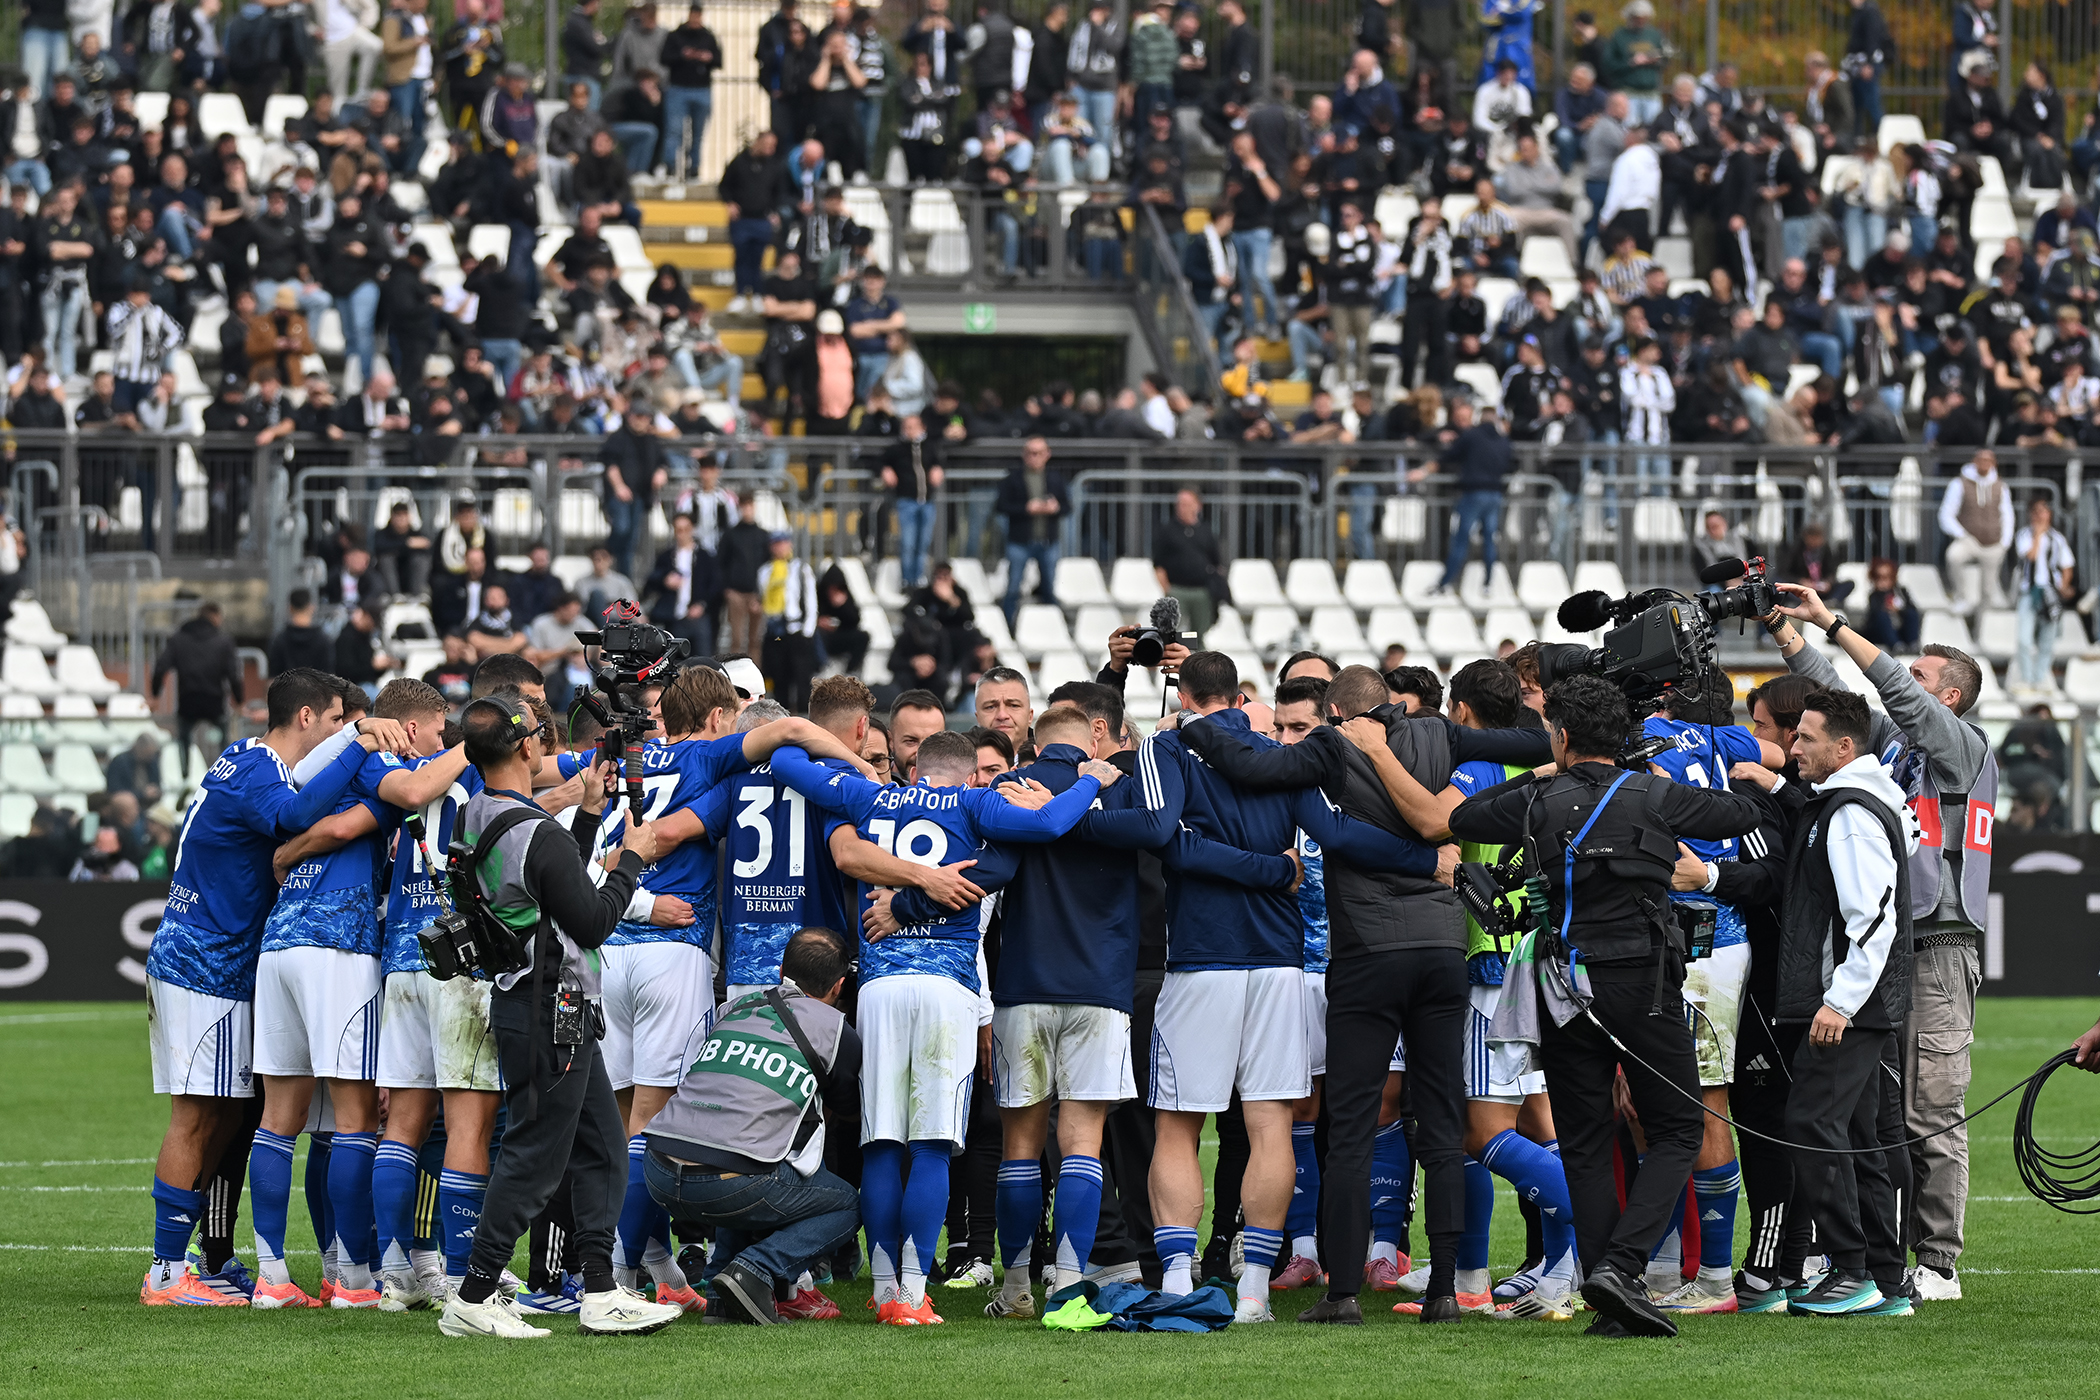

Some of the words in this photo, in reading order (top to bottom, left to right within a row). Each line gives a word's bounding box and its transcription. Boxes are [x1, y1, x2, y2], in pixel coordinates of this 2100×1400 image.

[649, 658, 670, 677] RONIN
[733, 786, 806, 878] 31
[734, 885, 806, 897] NEUBERGER
[746, 901, 794, 912] BERMAN
[721, 1040, 819, 1099] PHOTO
[451, 1204, 482, 1220] COM
